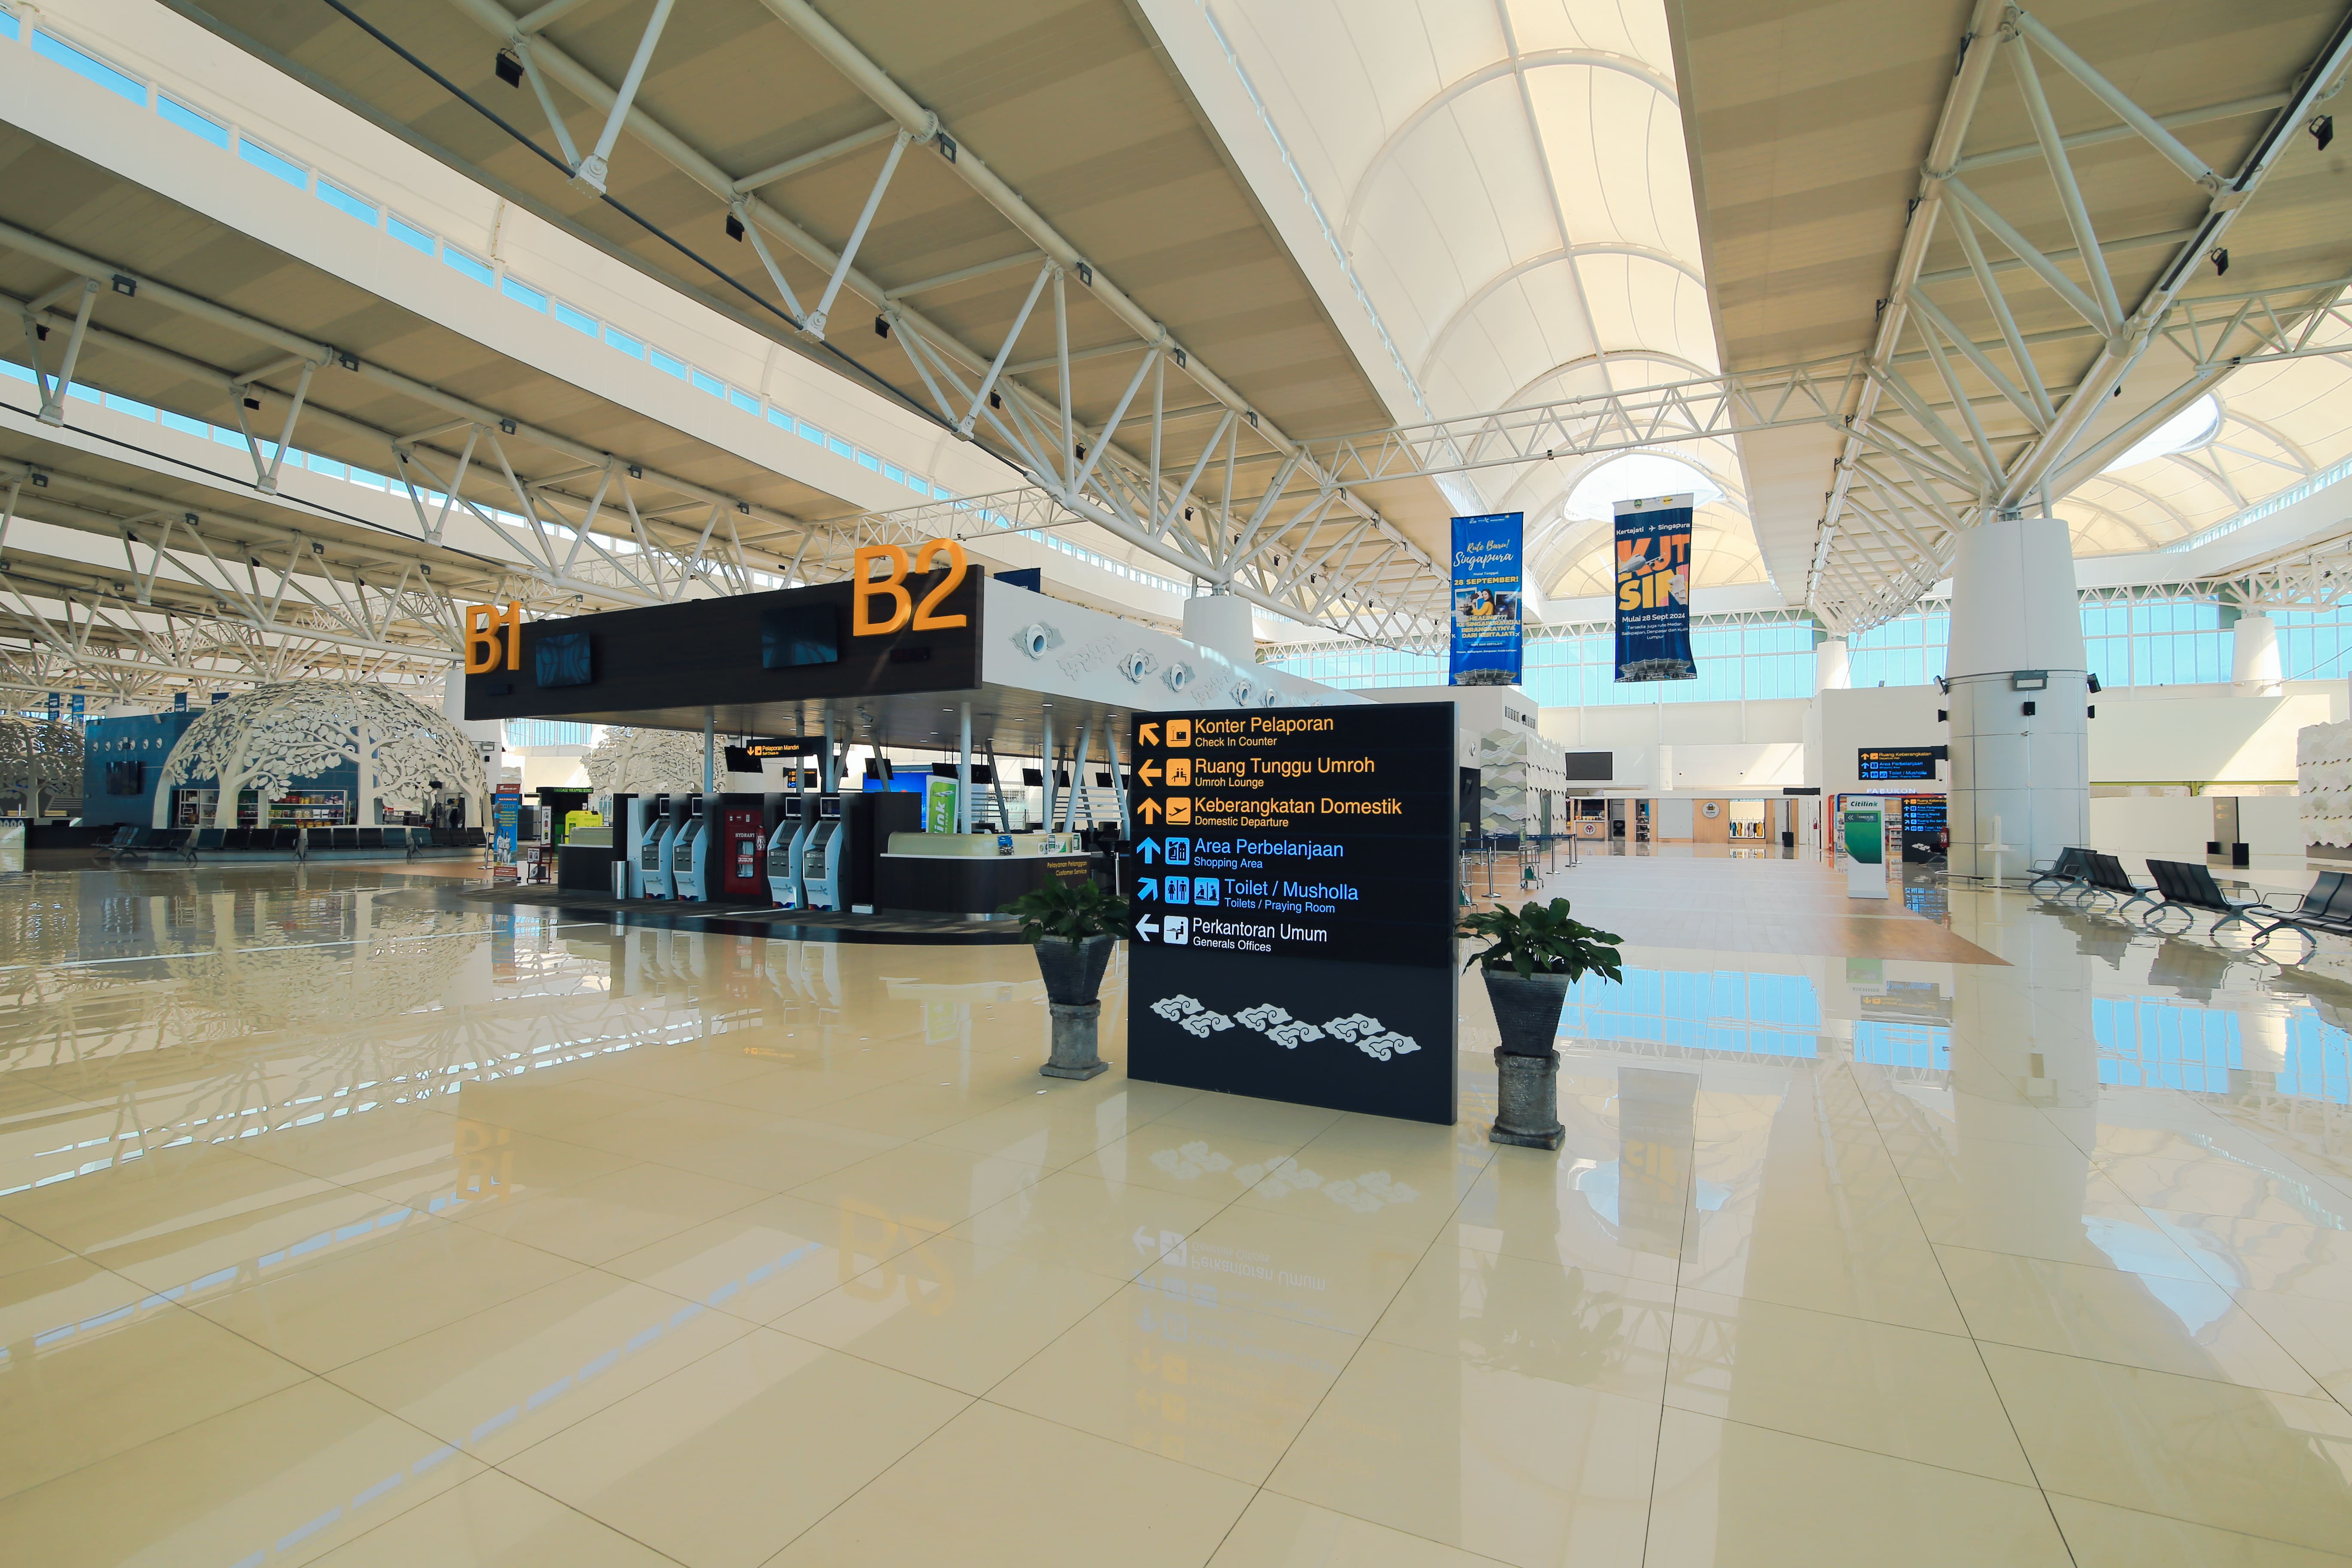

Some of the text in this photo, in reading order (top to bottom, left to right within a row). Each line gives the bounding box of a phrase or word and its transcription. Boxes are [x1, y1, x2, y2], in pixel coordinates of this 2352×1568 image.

[1616, 527, 1644, 536] Kertajati
[1467, 539, 1510, 553] Rute Baru!
[1453, 551, 1514, 571] Singapura
[1617, 534, 1690, 583] KJT
[853, 538, 967, 637] B2
[1466, 576, 1519, 585] SEPTEMBER!
[1618, 564, 1689, 611] SIN
[465, 601, 521, 674] B1
[1196, 717, 1333, 735] Konter Pelaporan
[1196, 737, 1277, 747] Check In Counter
[1196, 757, 1374, 777] Ruang Tunggu Umroh
[1196, 778, 1264, 789] Umroh Lounge
[934, 801, 945, 833] ink
[1195, 797, 1402, 817] Keberangkatan Domestik
[1195, 816, 1288, 828] Domestic Departure
[1195, 838, 1343, 860] Area Perbelanjaan
[1194, 857, 1263, 870] Shopping Area
[1225, 879, 1358, 900] Toilet / Musholla
[1225, 898, 1335, 913] Toilets / Praying Room
[1193, 918, 1326, 942] Perkantoran Umum
[1193, 937, 1271, 952] Generals Offices
